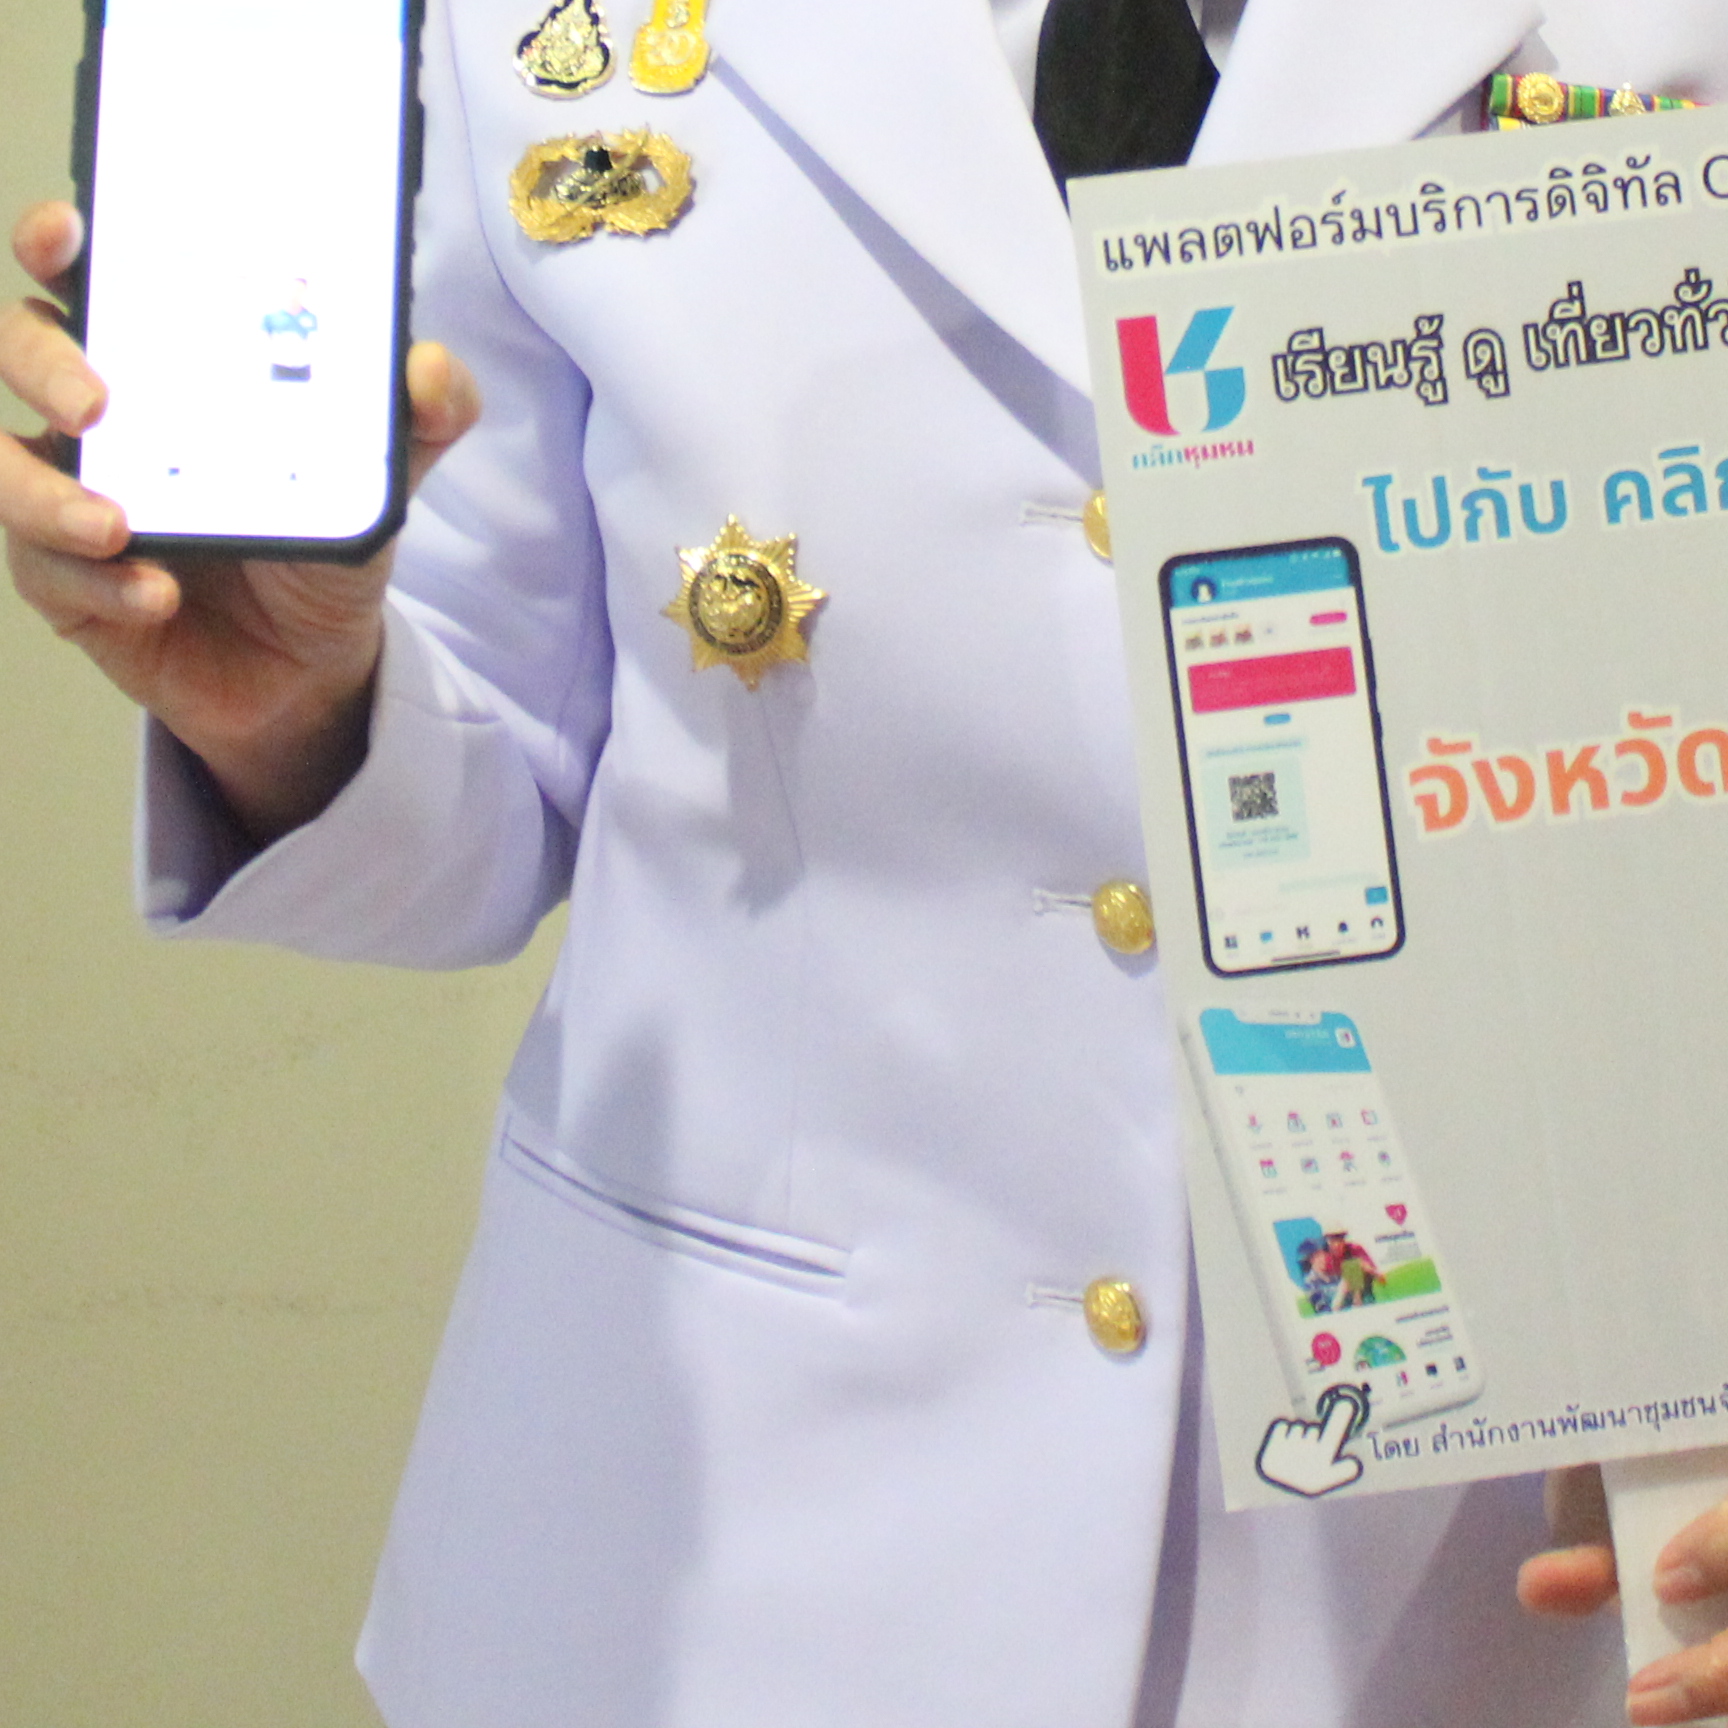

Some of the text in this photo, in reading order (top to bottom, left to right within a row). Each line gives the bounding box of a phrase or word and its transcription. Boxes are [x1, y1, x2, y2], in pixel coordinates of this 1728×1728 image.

[1101, 154, 1683, 271] แพลตฟอร์มบริการดิจิทัล
[1272, 314, 1449, 406] เรียนรู้
[1463, 328, 1509, 399] ดู
[1363, 465, 1569, 555] ไปกับ
[1369, 1431, 1420, 1462] โดย
